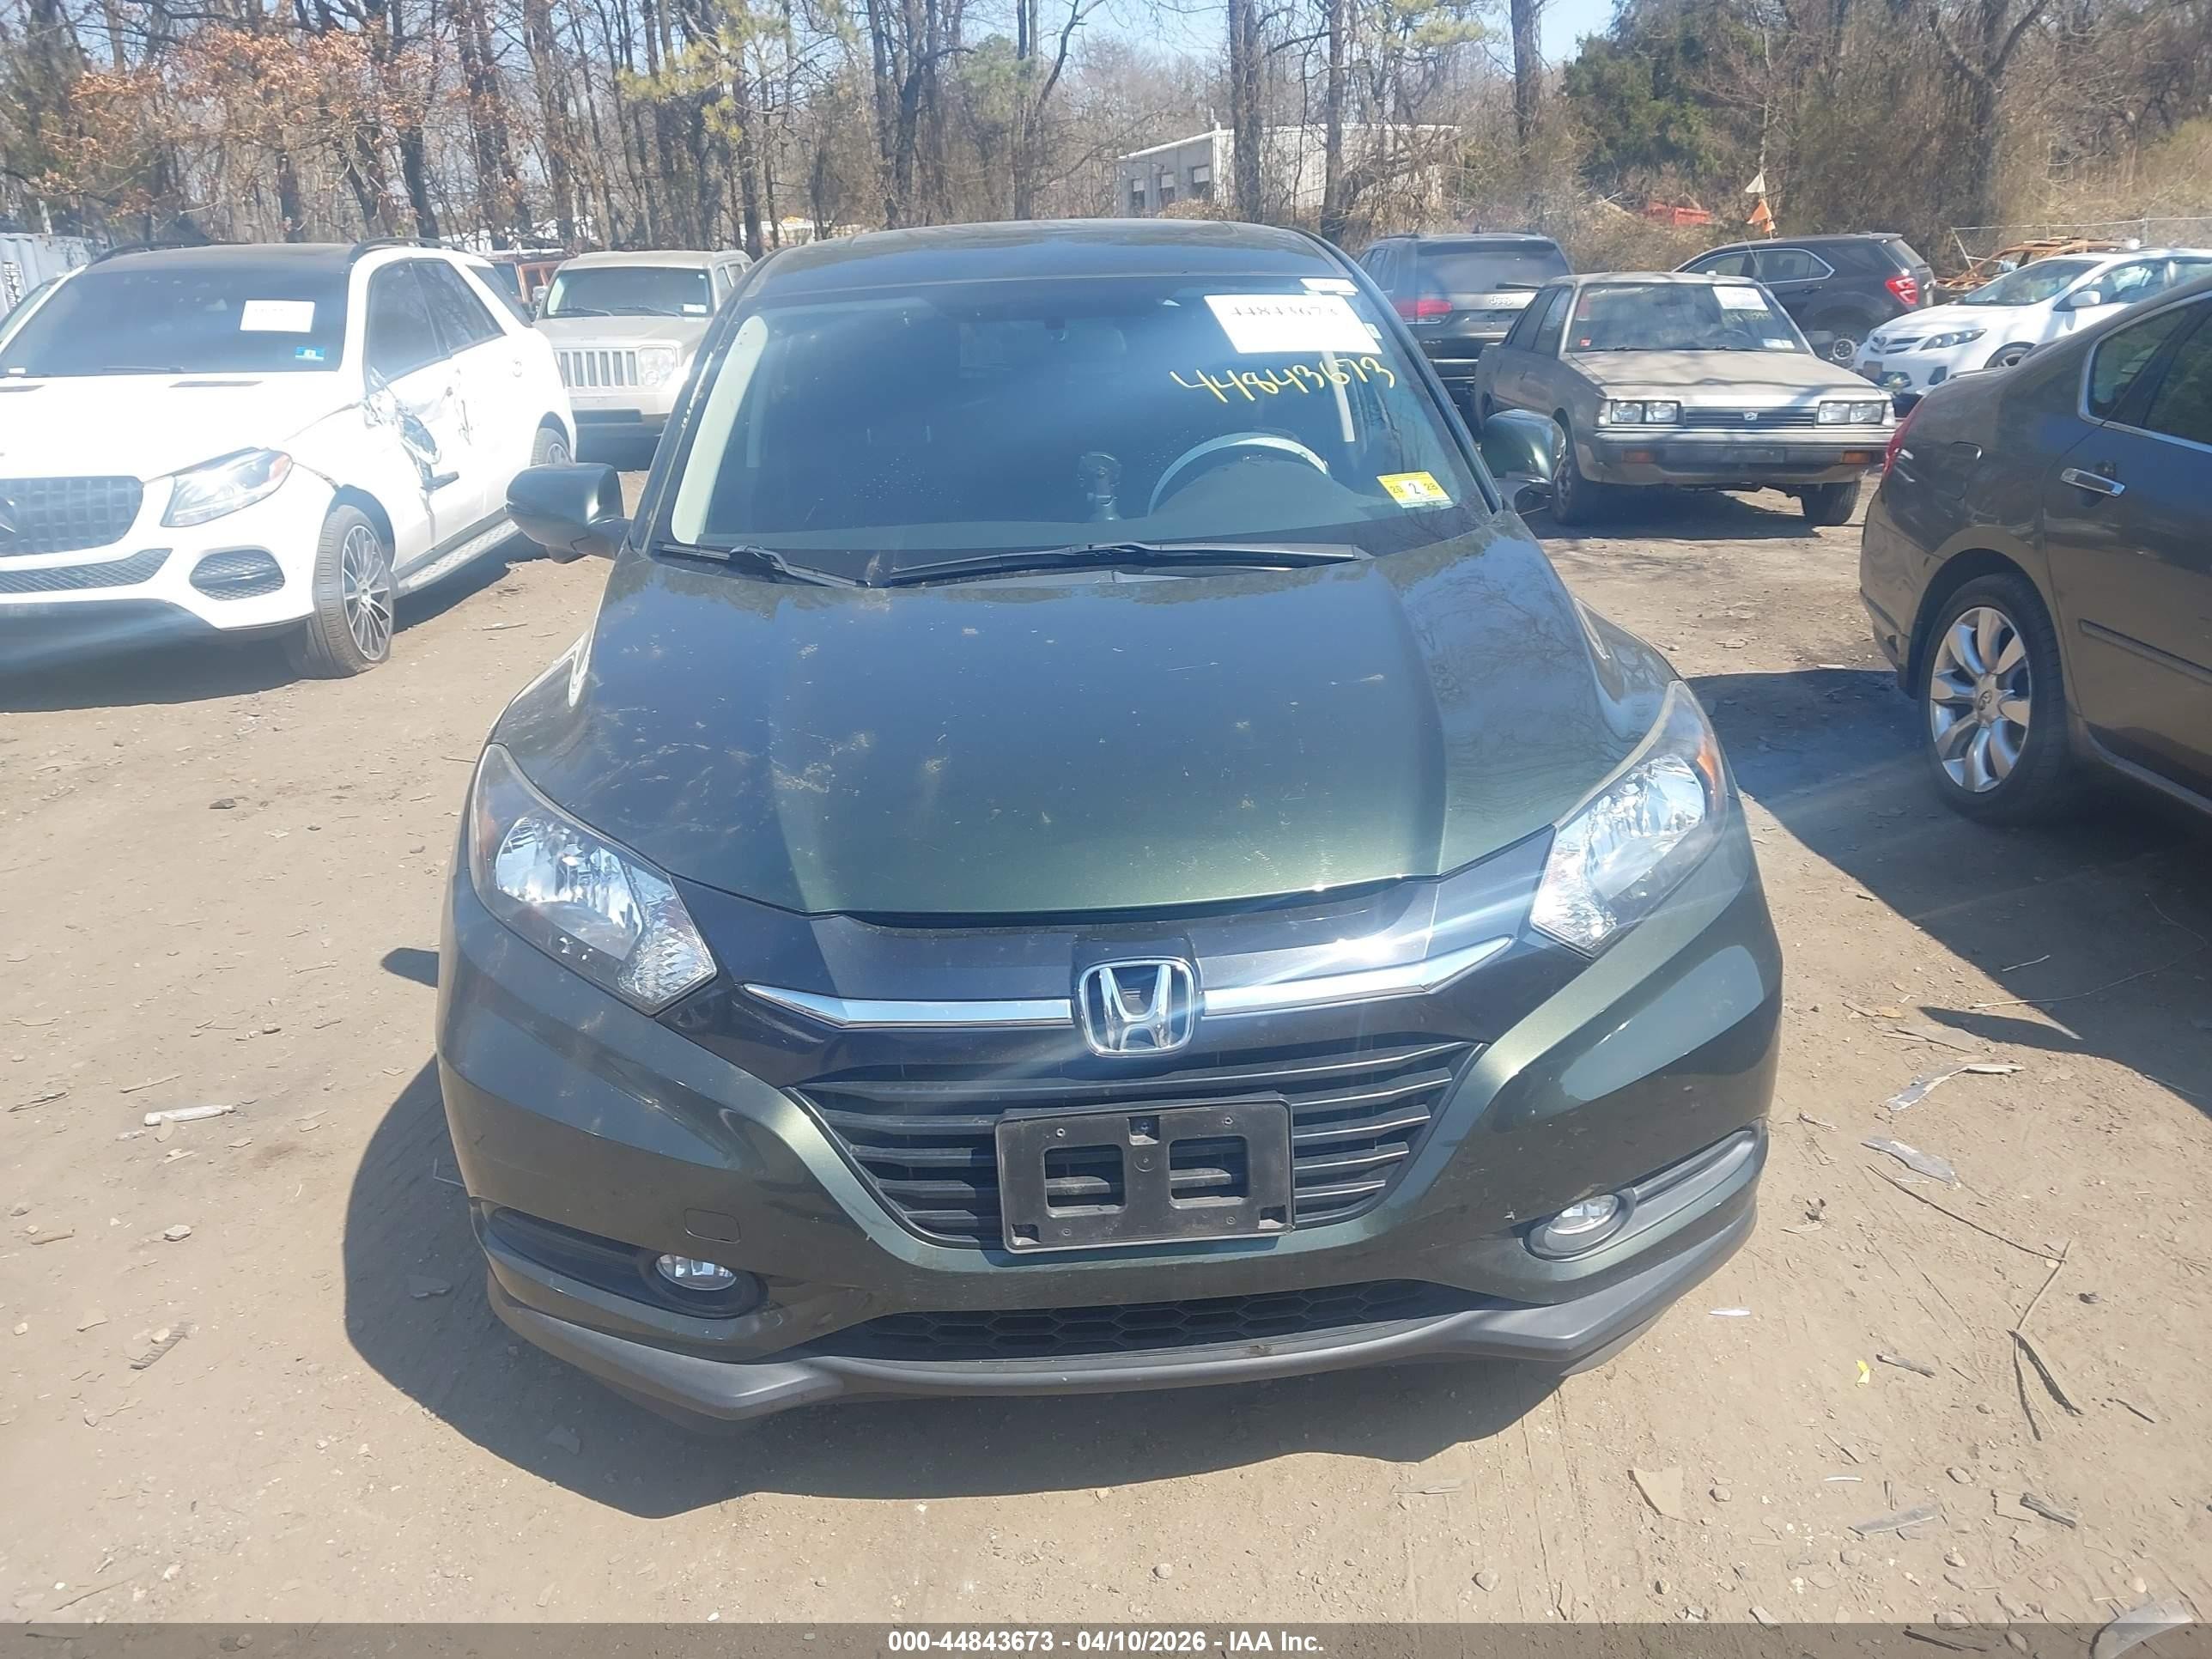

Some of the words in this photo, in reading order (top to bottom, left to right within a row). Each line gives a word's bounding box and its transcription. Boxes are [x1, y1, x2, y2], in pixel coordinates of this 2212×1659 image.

[1490, 295, 1512, 306] Jeep
[1170, 356, 1395, 403] 44843673
[1408, 483, 1421, 495] 2
